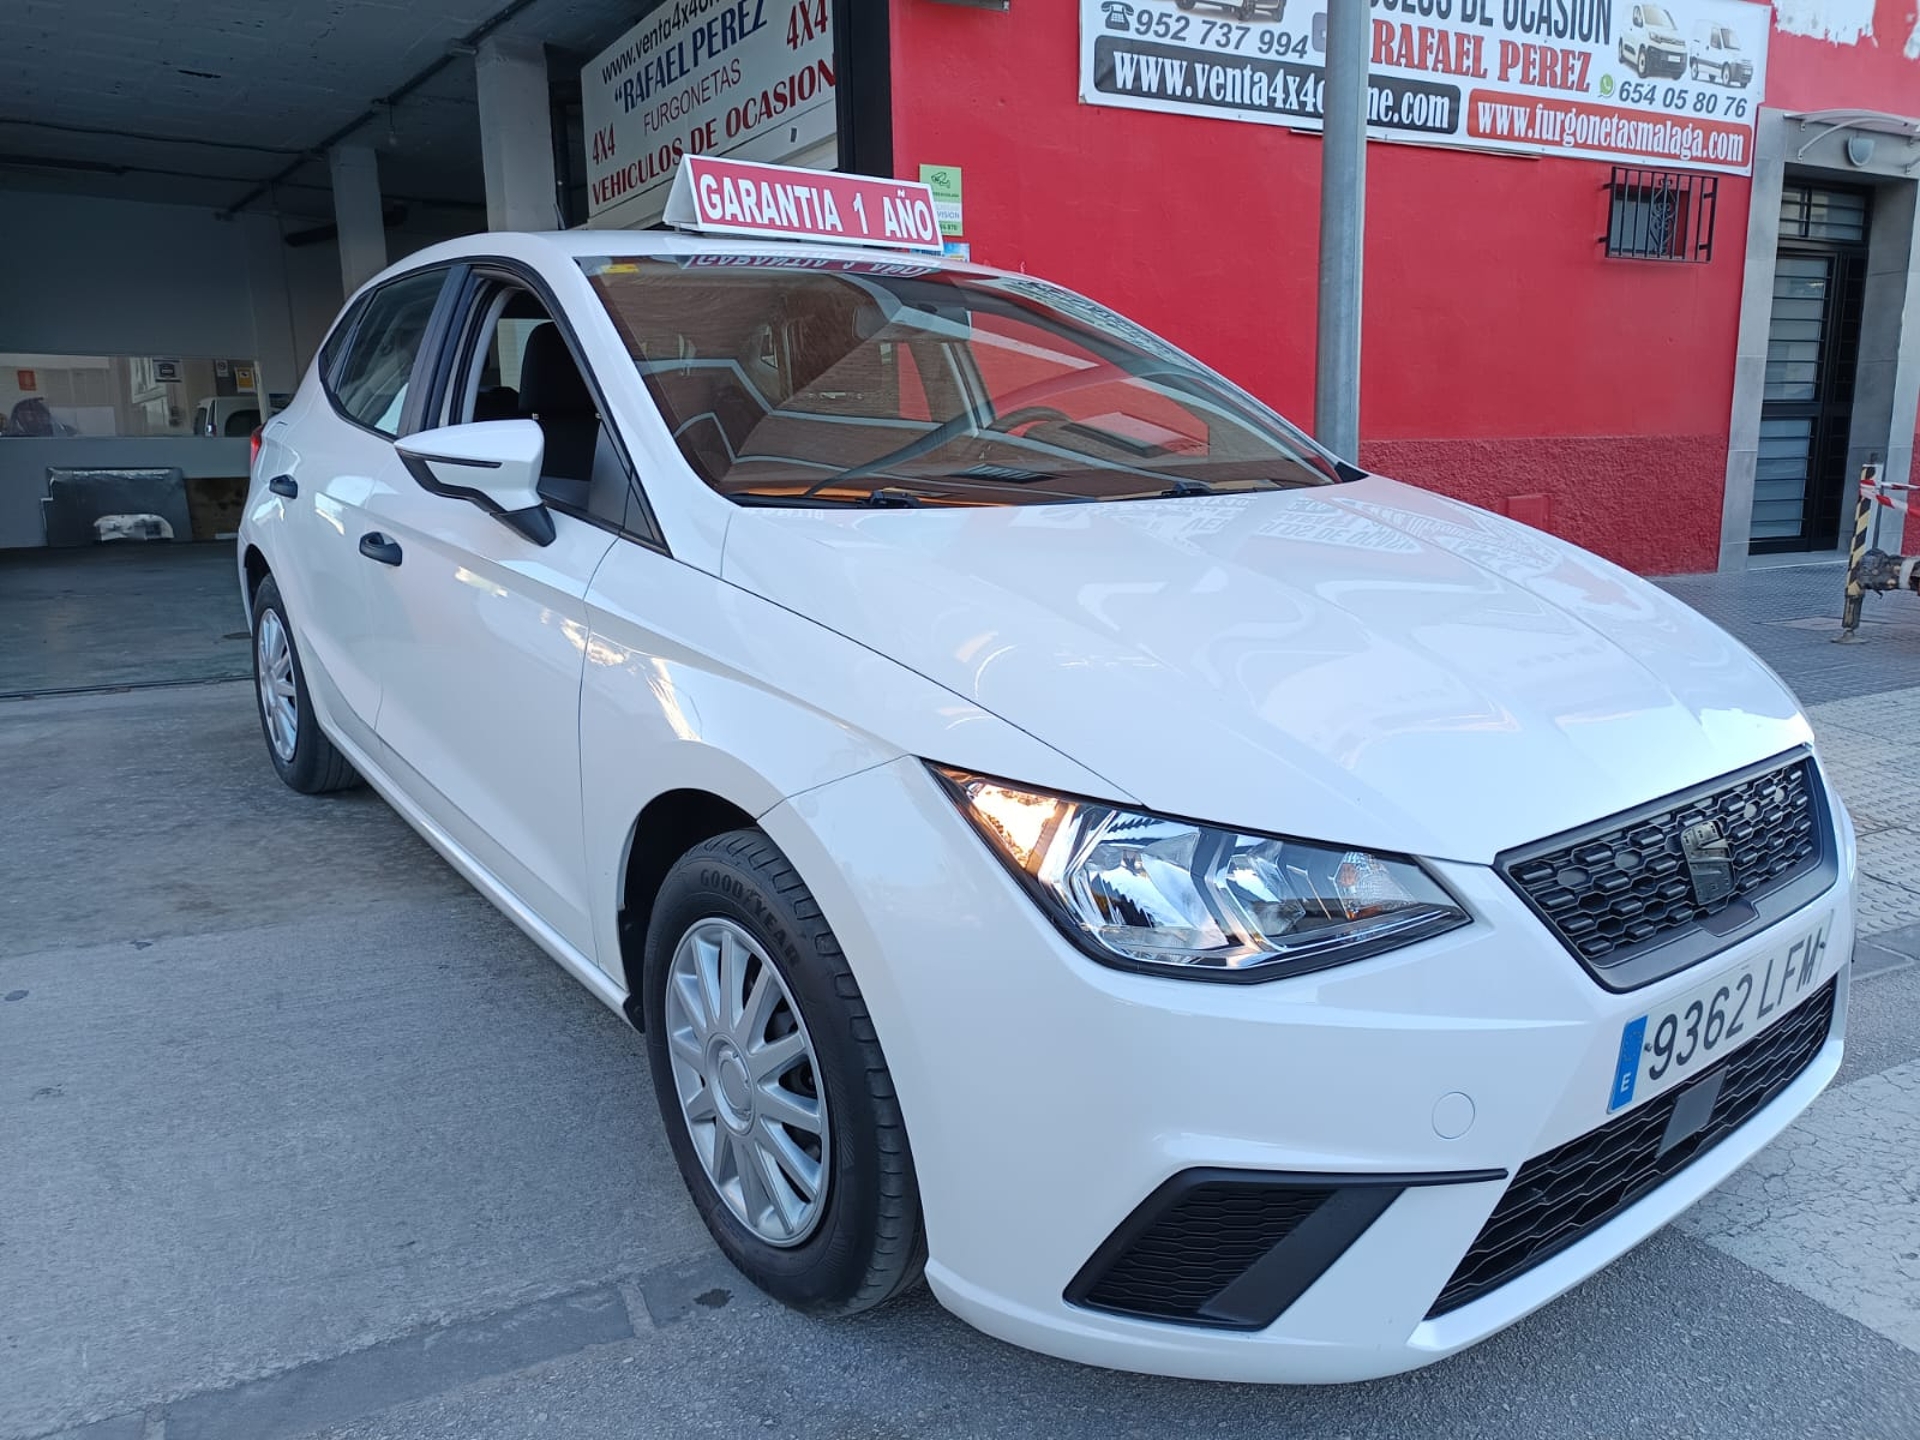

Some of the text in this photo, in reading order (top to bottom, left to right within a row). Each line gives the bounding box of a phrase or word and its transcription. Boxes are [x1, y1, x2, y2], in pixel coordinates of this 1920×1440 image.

[692, 0, 768, 68] PEREZ
[1134, 9, 1309, 59] 952 737 994
[1371, 19, 1592, 93] RAFAEL PEREZ
[644, 58, 741, 137] FURGONETAS
[1618, 81, 1748, 118] 654 05 80 76
[592, 58, 836, 206] VEHICULOS DE OCASION
[1477, 101, 1744, 162] www.furgonetasmalaga.com
[700, 174, 933, 241] GARANTIA 1 AÑO
[1650, 973, 1753, 1081] 9362
[1620, 1073, 1631, 1093] E
